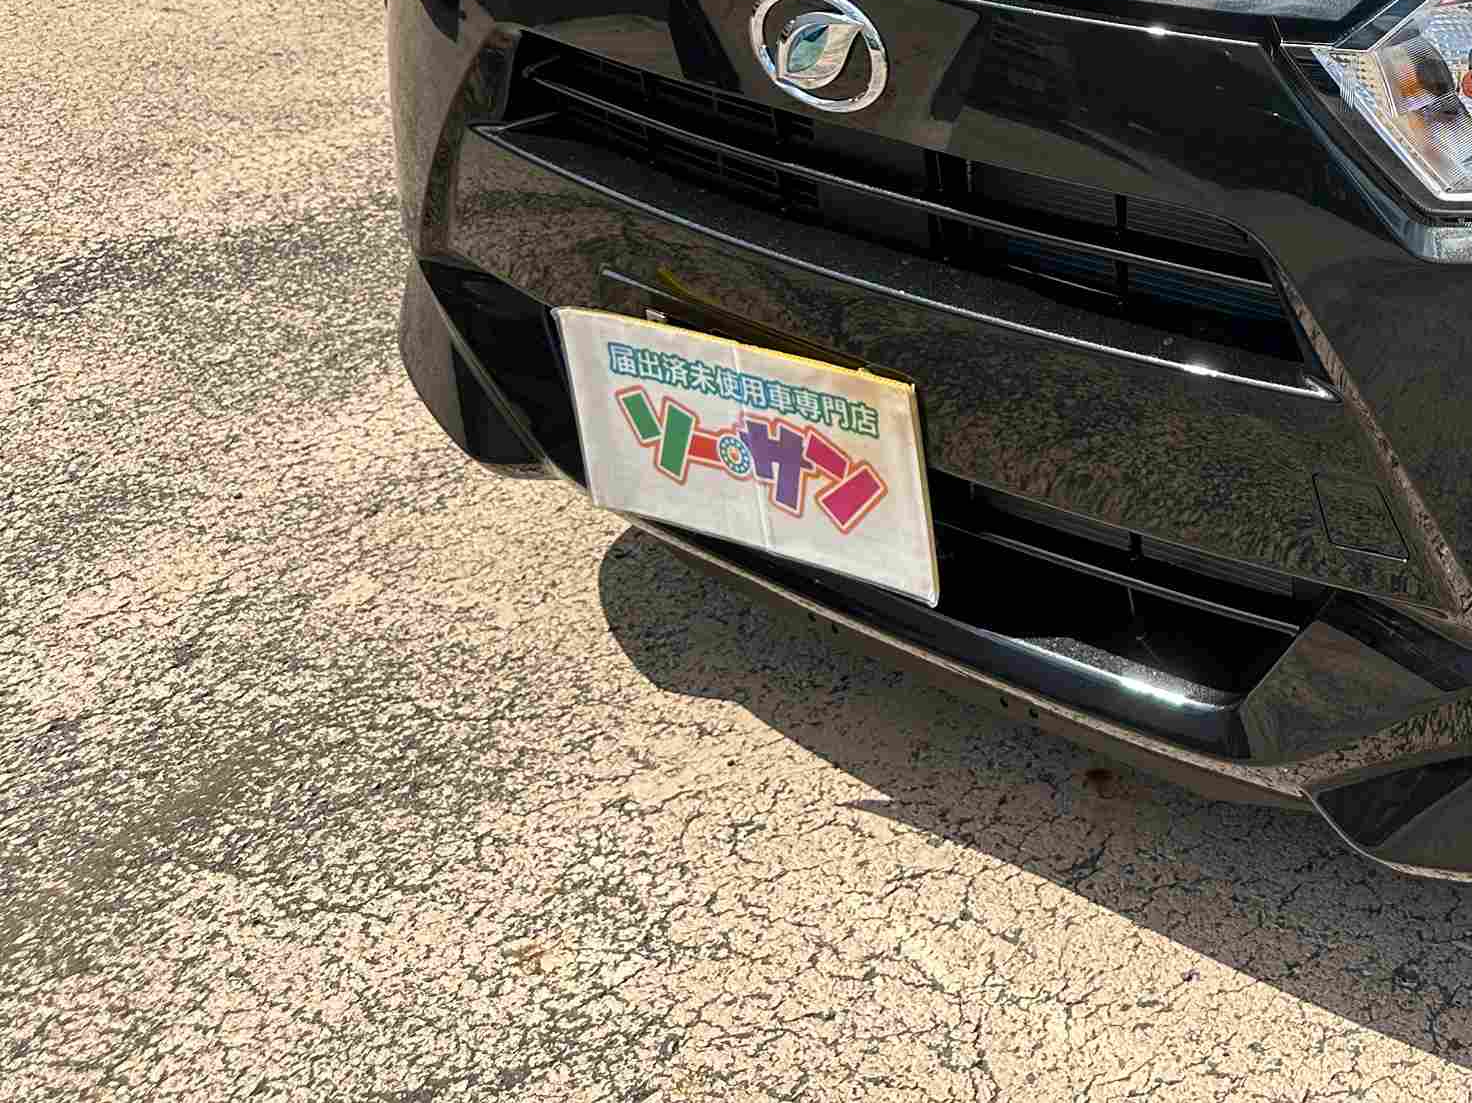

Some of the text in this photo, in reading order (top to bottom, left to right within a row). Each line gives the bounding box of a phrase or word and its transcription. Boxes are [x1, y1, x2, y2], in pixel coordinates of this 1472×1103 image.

[608, 342, 880, 438] 届出済未使用車専門店
